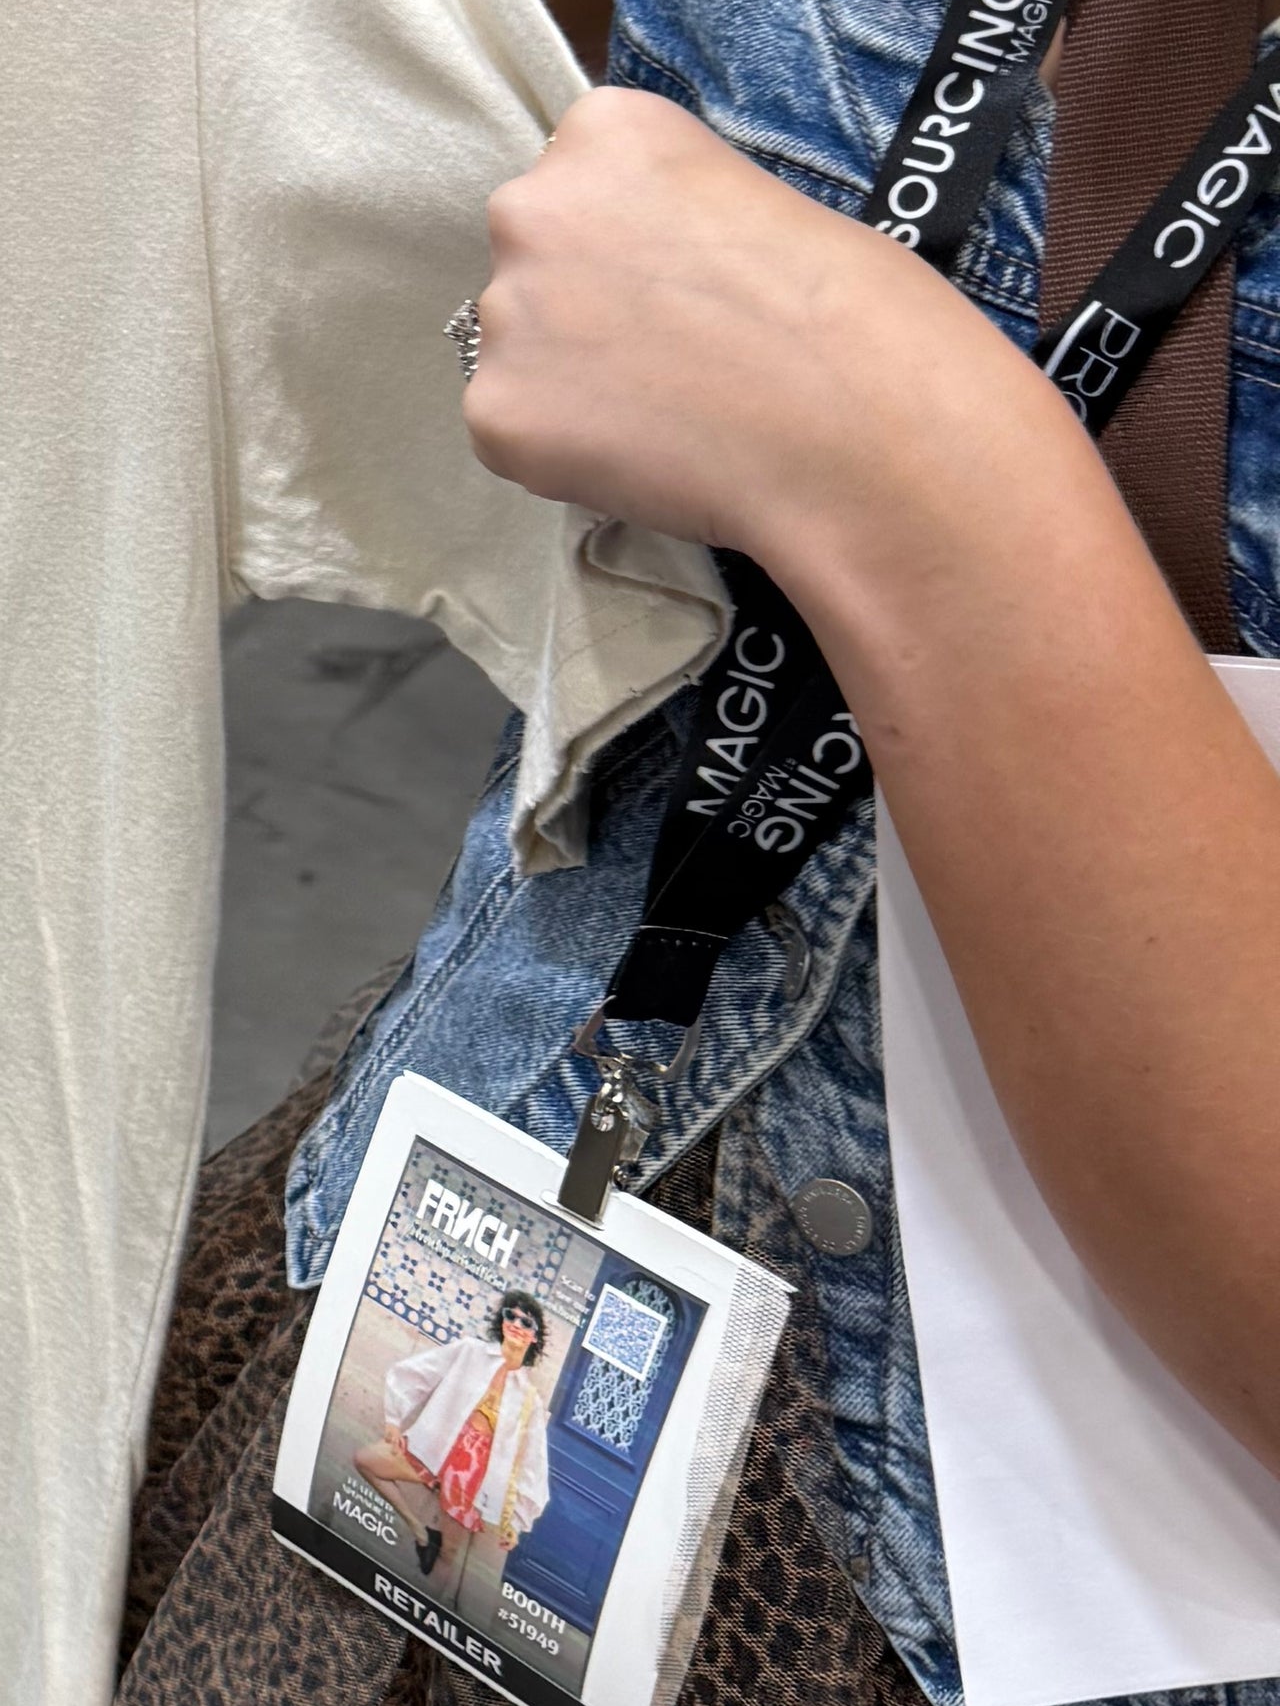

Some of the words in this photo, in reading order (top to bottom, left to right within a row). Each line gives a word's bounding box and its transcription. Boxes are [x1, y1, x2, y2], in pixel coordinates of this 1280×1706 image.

[727, 765, 790, 839] MAGIC
[333, 1491, 399, 1546] MAGIC
[374, 1573, 503, 1677] RETAILER
[497, 1607, 561, 1656] #51949
[501, 1581, 567, 1634] BOOTH
